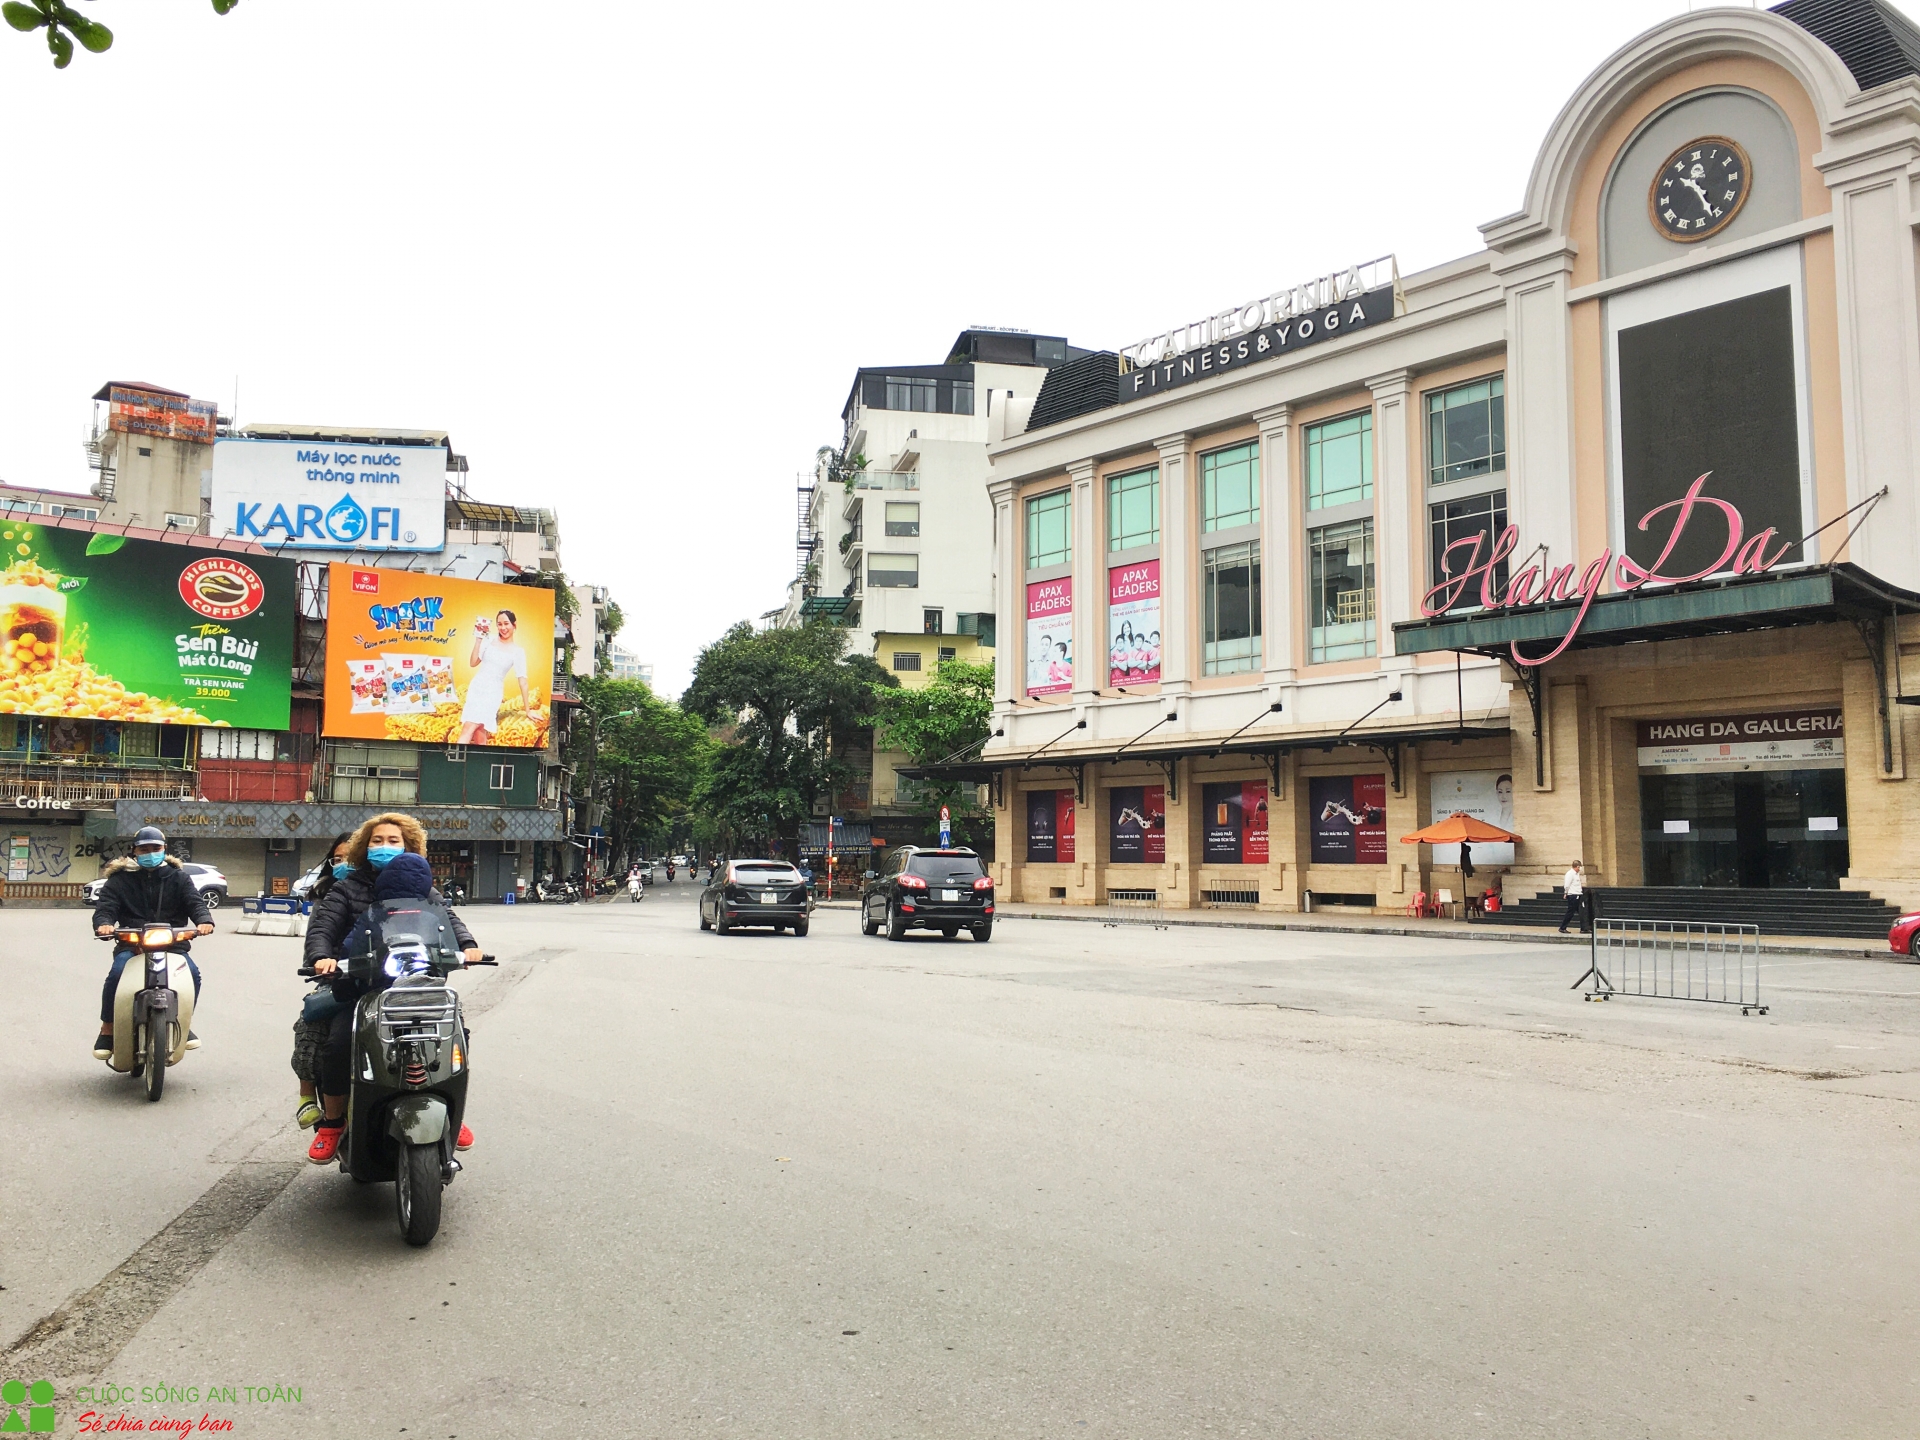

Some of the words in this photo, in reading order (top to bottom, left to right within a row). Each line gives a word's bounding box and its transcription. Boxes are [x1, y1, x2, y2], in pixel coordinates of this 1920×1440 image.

[1135, 264, 1369, 368] CALIFORNIA
[297, 450, 329, 465] Máy
[335, 451, 356, 467] lọc
[361, 453, 401, 466] nước
[306, 468, 355, 484] thông
[360, 471, 400, 484] minh
[236, 492, 400, 542] KAROFI
[184, 561, 259, 590] HIGHLANDS
[1122, 568, 1148, 584] APAX
[1421, 523, 1612, 666] Hang
[1615, 470, 1793, 591] Da
[354, 583, 376, 591] VIFON
[1039, 585, 1062, 599] APAX
[1112, 580, 1159, 598] LEADERS
[192, 599, 250, 616] COFFEE
[1030, 596, 1071, 612] LEADERS
[175, 634, 217, 652] Sen
[221, 636, 259, 660] Bùi
[178, 653, 206, 667] Mát
[220, 656, 252, 675] Long
[184, 677, 201, 686] TRÀ
[221, 680, 244, 689] VÀNG
[196, 687, 230, 697] 39.000
[1650, 723, 1704, 739] HANG
[1710, 721, 1739, 736] DA
[1744, 715, 1843, 734] GALLERIA
[15, 796, 71, 810] Coffee
[75, 844, 95, 857] 26
